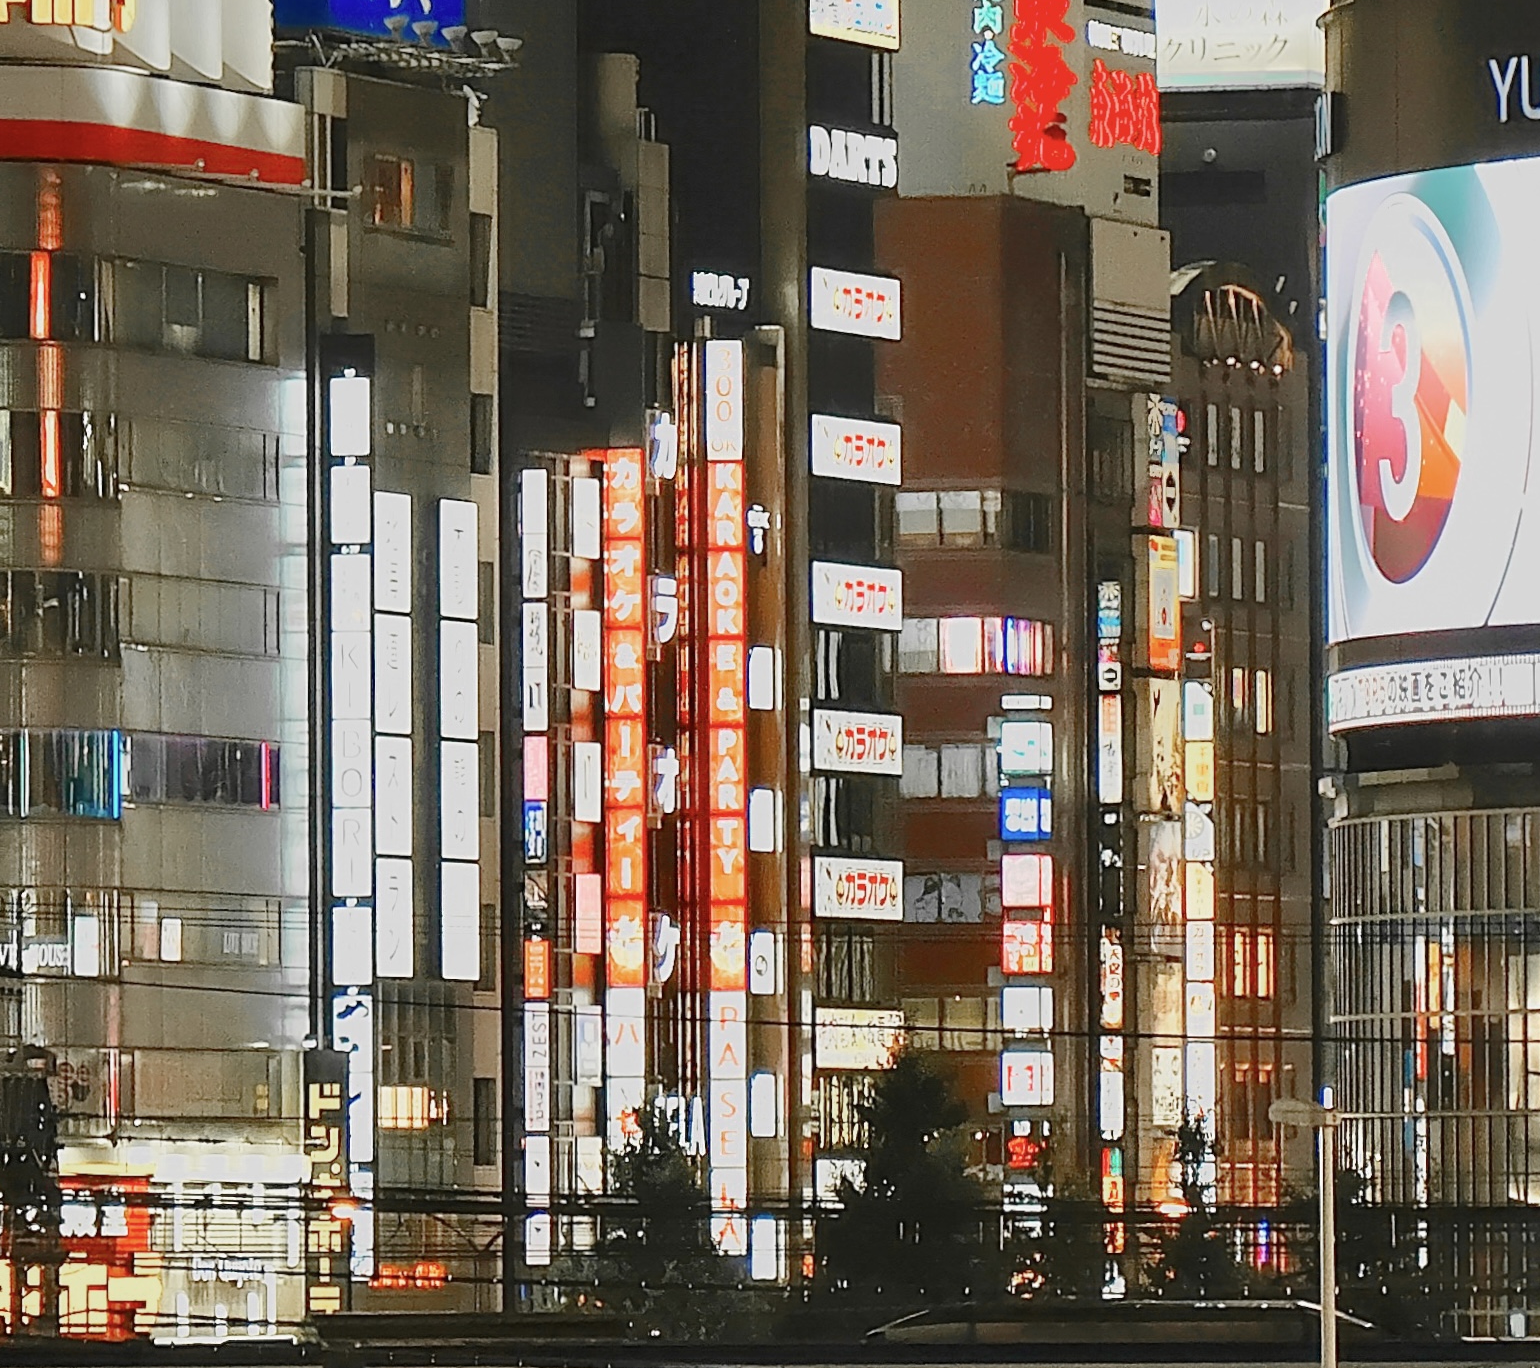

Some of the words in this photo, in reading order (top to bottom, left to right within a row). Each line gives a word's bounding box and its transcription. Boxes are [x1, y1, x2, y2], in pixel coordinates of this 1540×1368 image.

[1162, 36, 1292, 65] クリニック
[809, 125, 898, 188] DARTS
[842, 286, 887, 323] カラオケ
[843, 434, 887, 469] カラオケ
[714, 461, 737, 672] KARAOKE
[844, 581, 887, 615] カラオケ
[715, 684, 738, 712] &
[844, 726, 888, 761] カラオケ
[716, 728, 739, 876] PARTY
[845, 871, 889, 909] カラオケ
